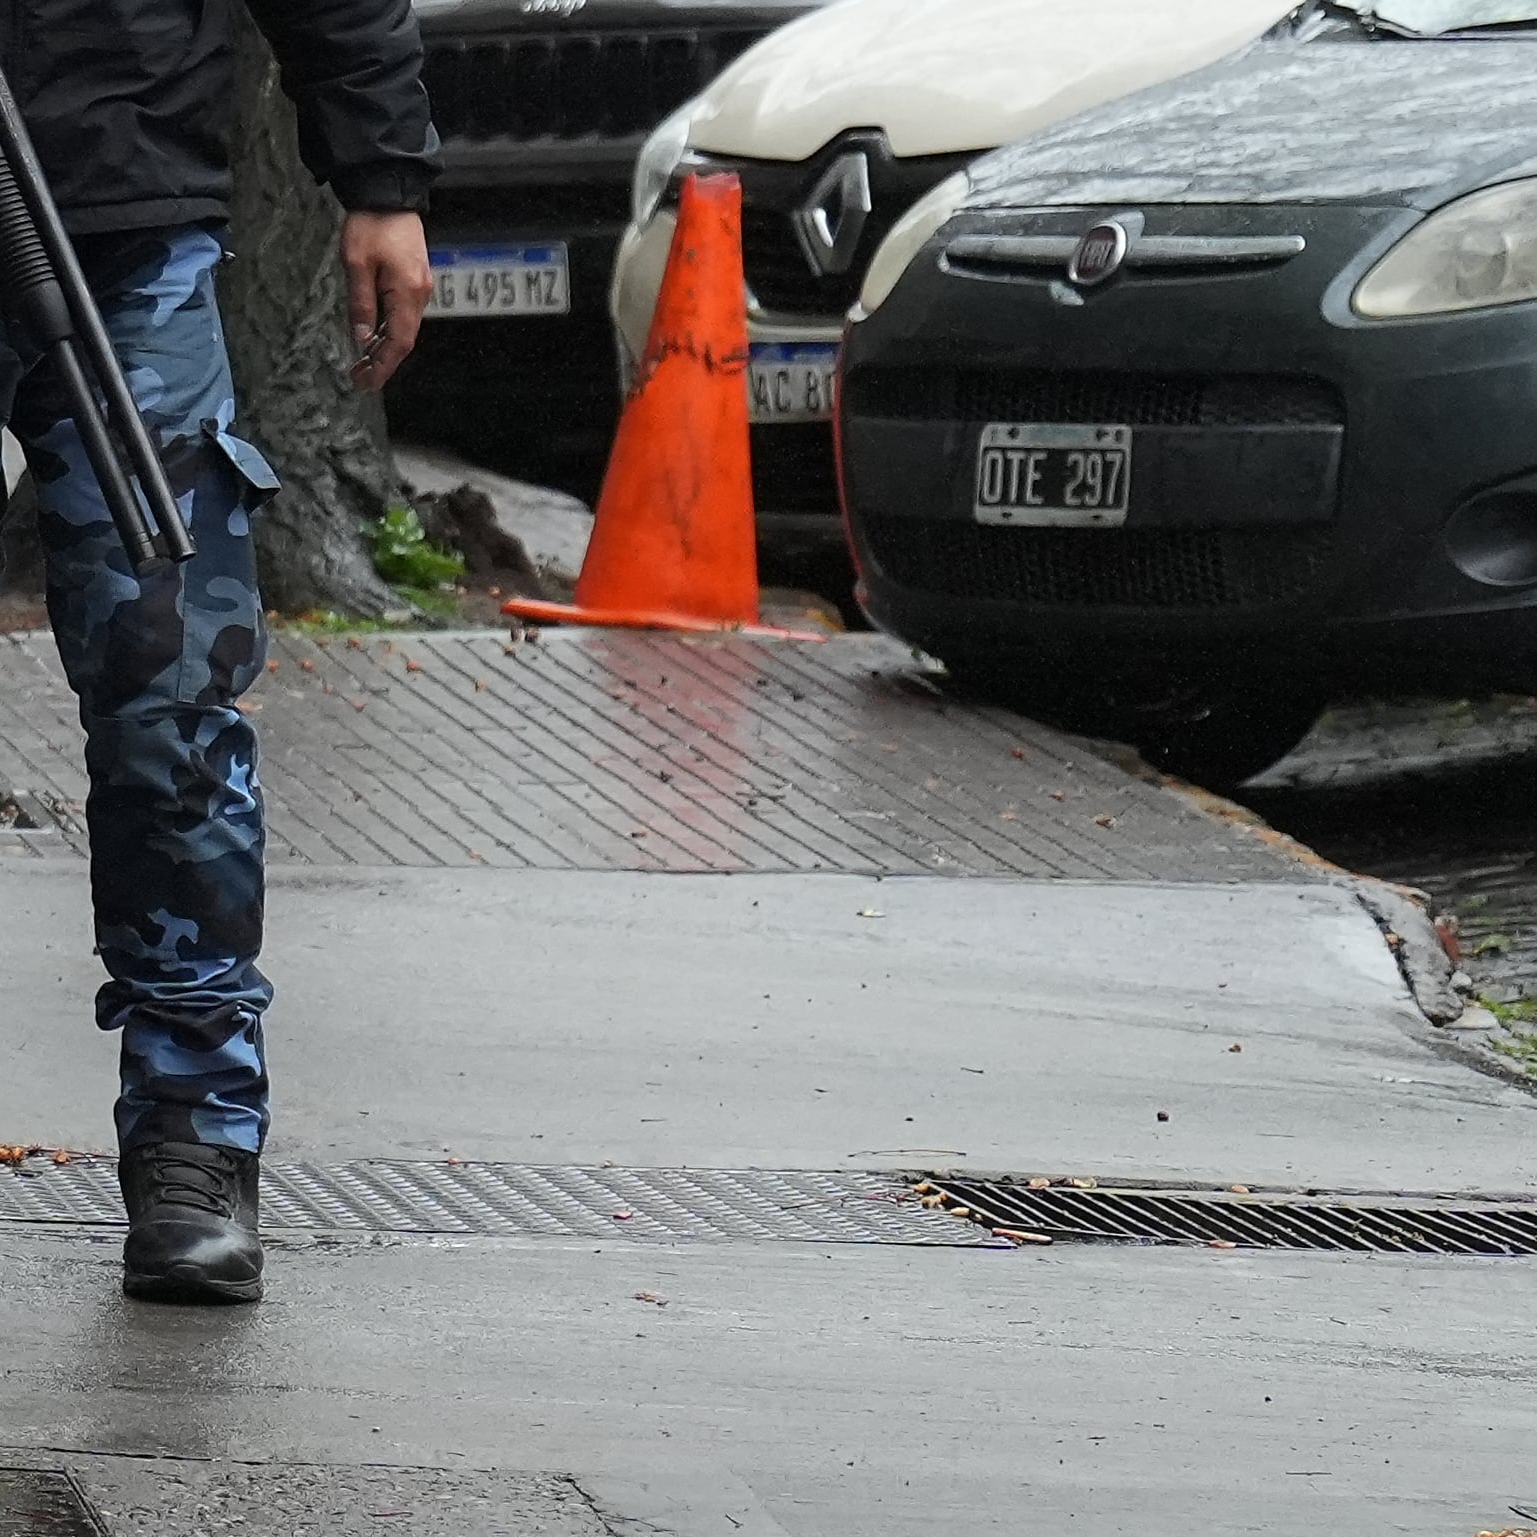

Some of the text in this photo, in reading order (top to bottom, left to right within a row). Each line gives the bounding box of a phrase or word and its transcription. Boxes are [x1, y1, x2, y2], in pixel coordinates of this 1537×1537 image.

[465, 271, 517, 308] 495
[525, 269, 560, 306] MZ
[755, 370, 791, 414] AC
[983, 450, 1124, 507] OTE 297
